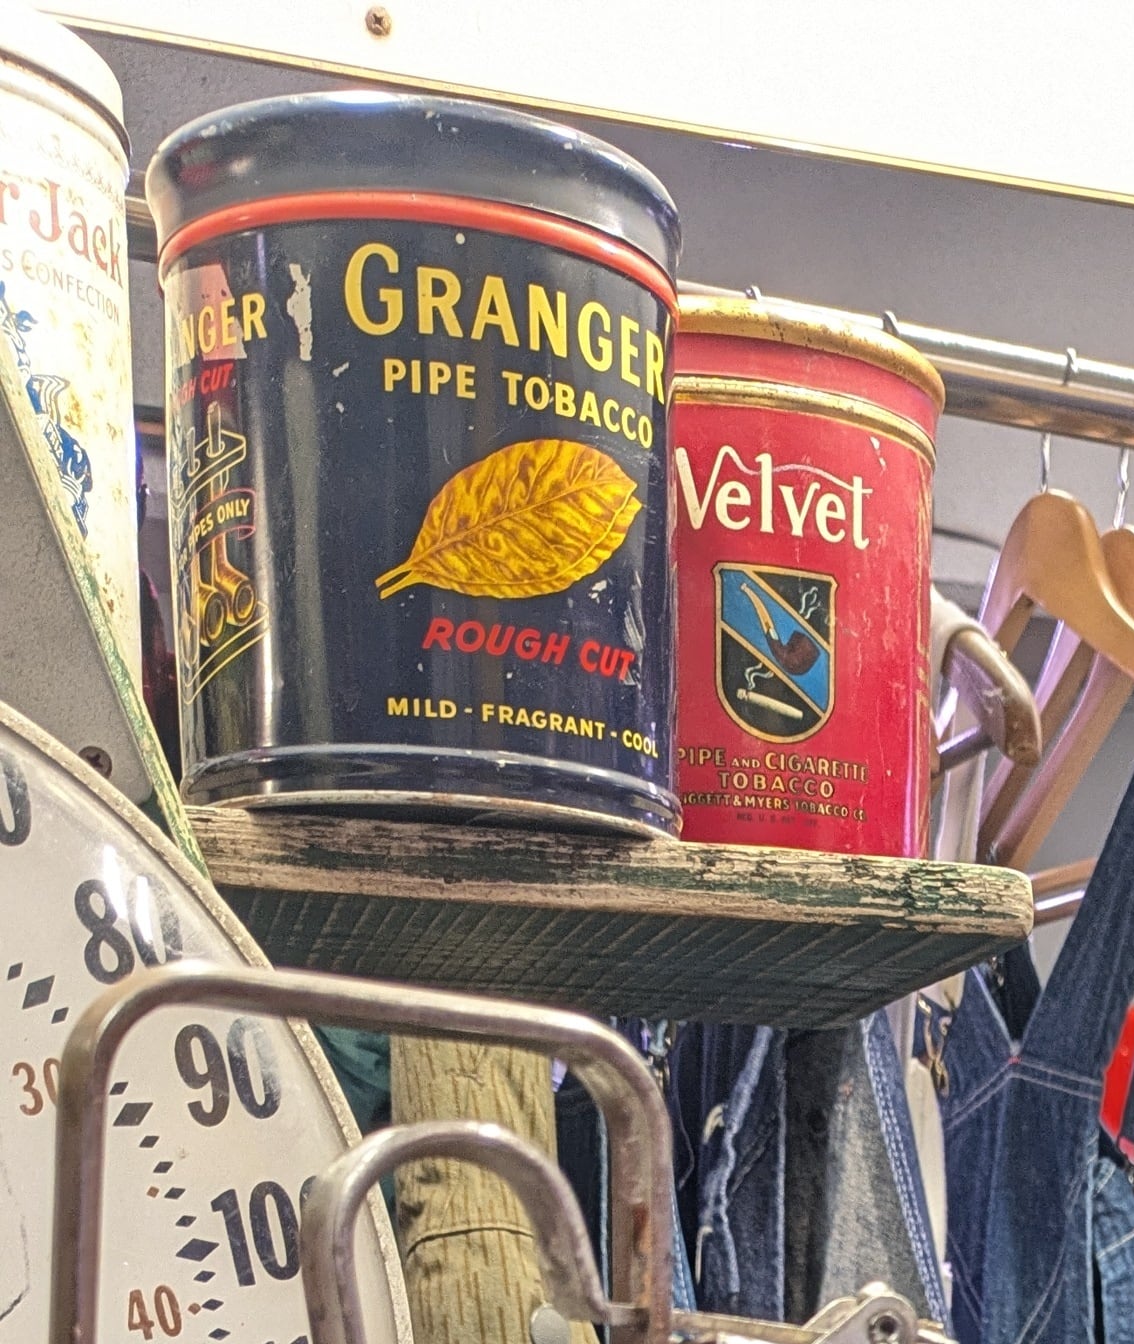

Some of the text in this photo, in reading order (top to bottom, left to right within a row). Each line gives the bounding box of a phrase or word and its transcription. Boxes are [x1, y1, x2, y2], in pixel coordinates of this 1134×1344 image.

[29, 178, 123, 288] Jack
[21, 250, 120, 325] CONFECTION
[181, 292, 268, 362] NGER
[344, 242, 665, 405] GRANGER
[201, 362, 234, 394] CUT
[384, 358, 653, 449] PIPE TOBACCO
[216, 498, 250, 523] ONLY
[675, 445, 873, 550] Velvet
[421, 617, 635, 681] ROUGH CUT
[387, 697, 457, 719] MILD
[481, 703, 605, 741] FRAGRANT
[622, 729, 659, 758] COOL
[683, 792, 731, 806] IGGETT
[745, 797, 789, 810] MYERS
[719, 771, 835, 798] TOBACCO
[731, 757, 761, 769] AND
[765, 752, 869, 783] CIGARETTE
[74, 876, 183, 985] 80
[175, 1016, 281, 1127] 90
[210, 1175, 310, 1287] 10
[127, 1284, 182, 1341] 40
